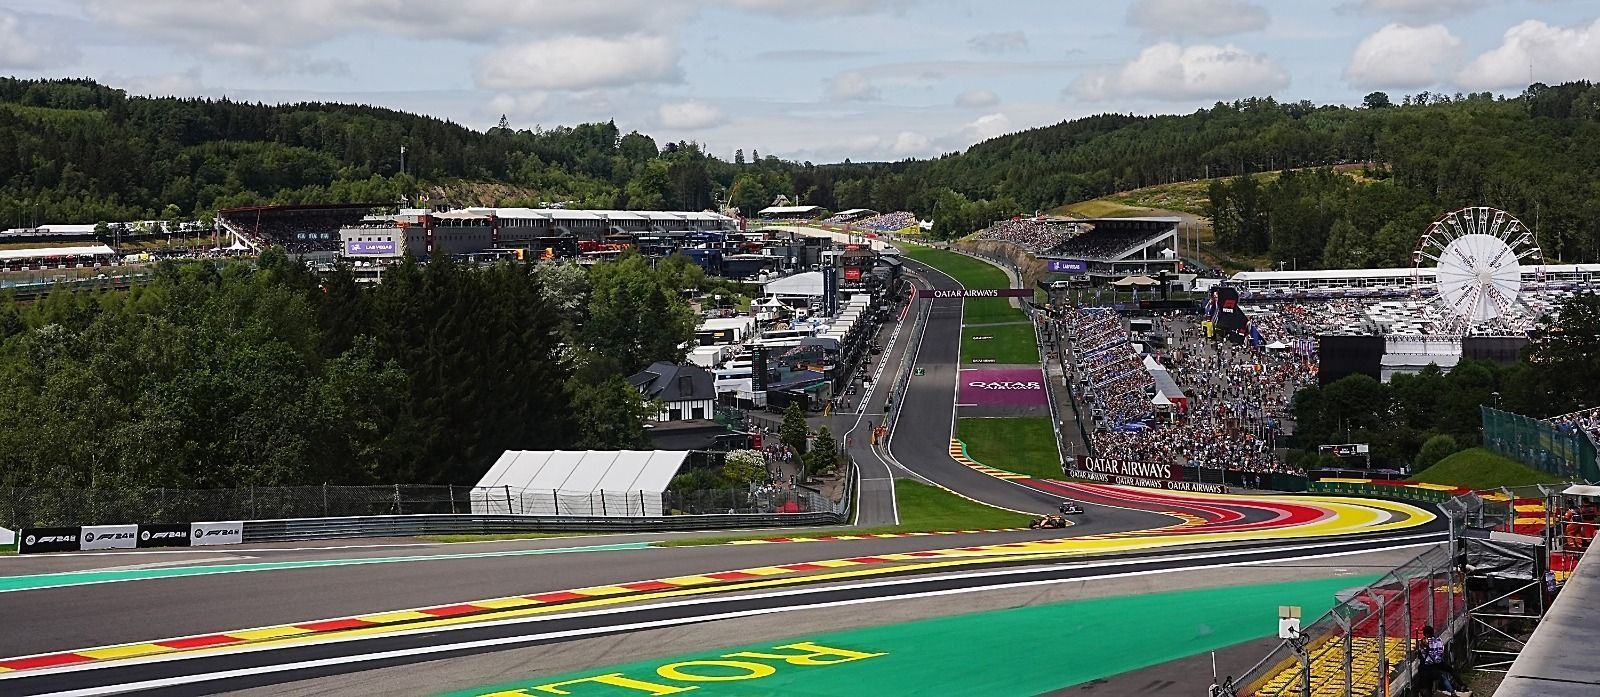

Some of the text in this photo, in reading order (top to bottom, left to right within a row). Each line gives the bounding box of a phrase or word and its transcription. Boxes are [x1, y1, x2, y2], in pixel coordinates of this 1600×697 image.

[934, 290, 962, 298] QATAR
[1085, 456, 1171, 479] QATAR AIRWAYS
[1115, 477, 1162, 488] QATAR AIRWAYS
[1167, 482, 1221, 494] QATAR AIRWAYS
